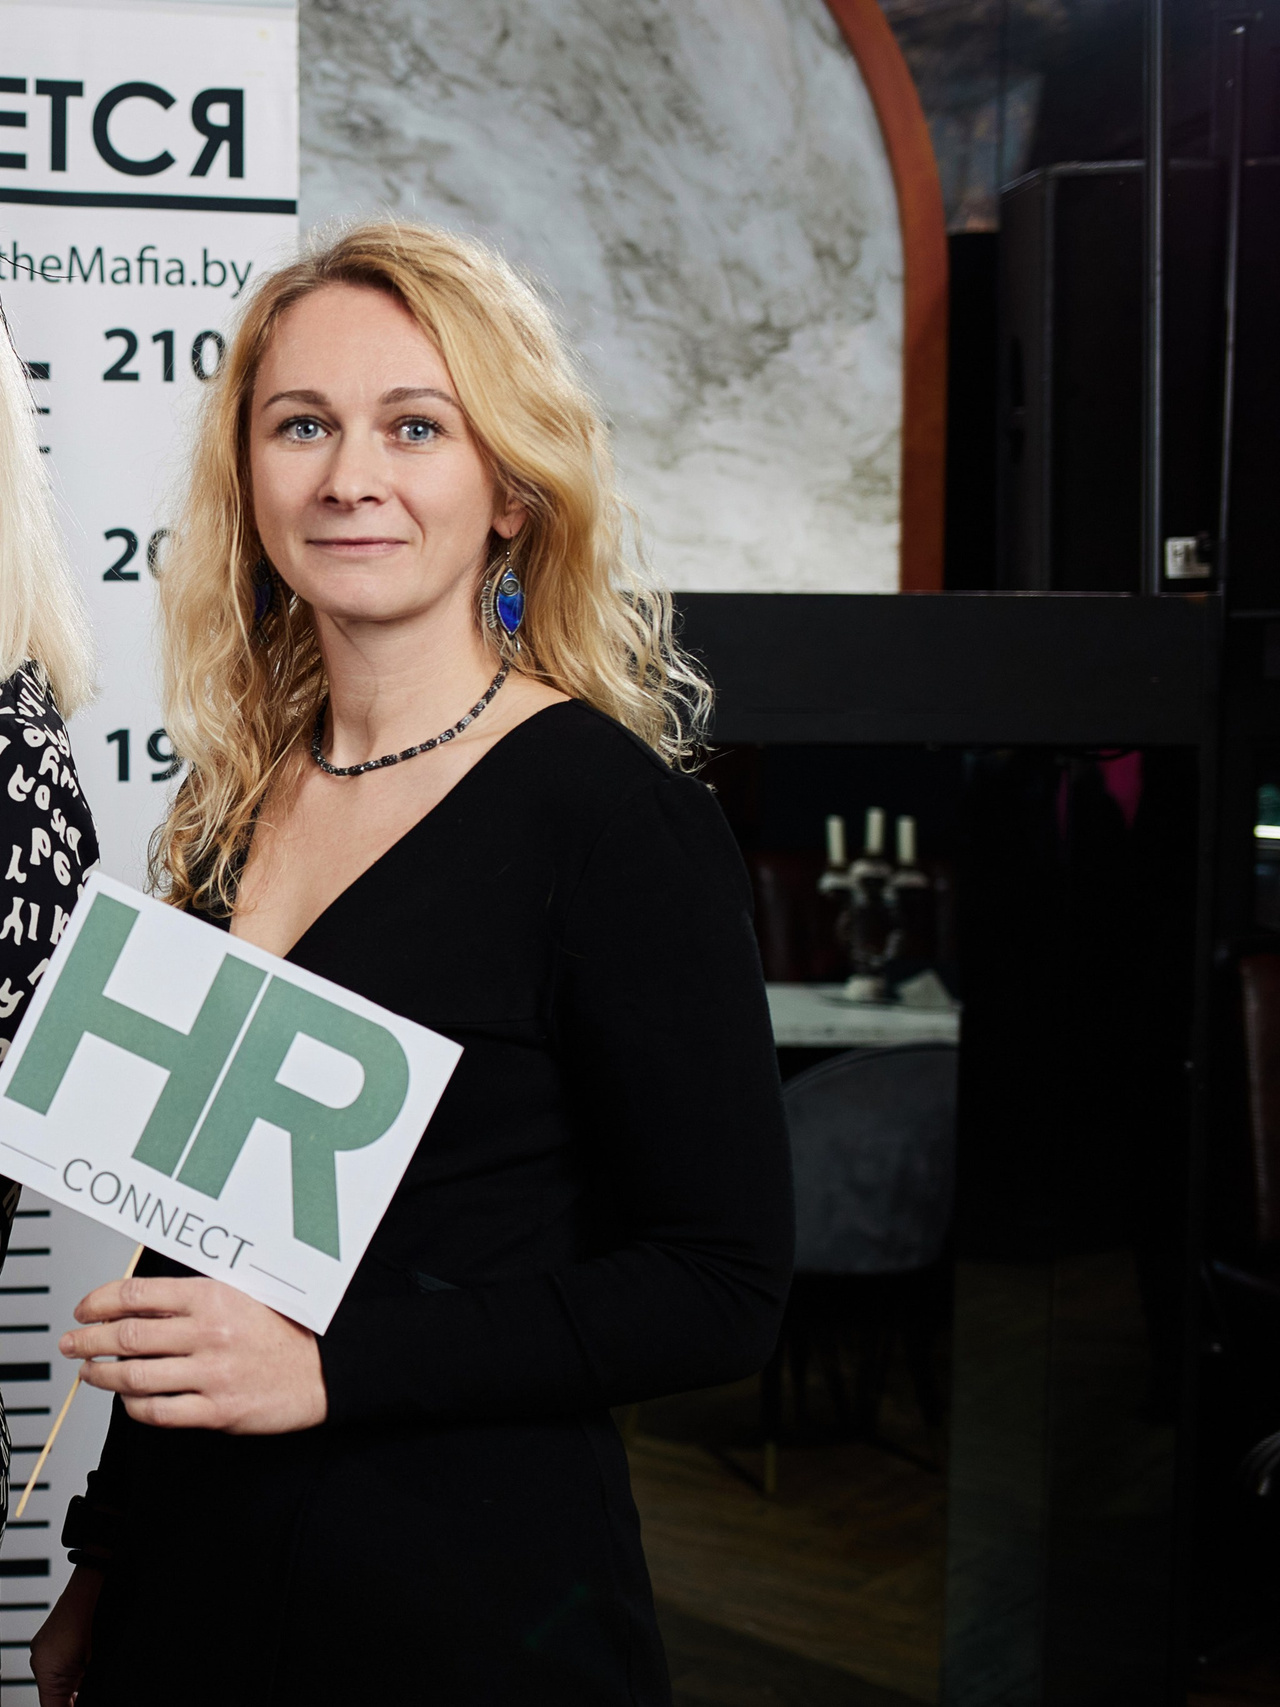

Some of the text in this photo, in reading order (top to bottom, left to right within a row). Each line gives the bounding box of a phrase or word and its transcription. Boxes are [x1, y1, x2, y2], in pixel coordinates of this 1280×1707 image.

[103, 328, 226, 383] 210
[106, 728, 183, 782] 19
[3, 891, 410, 1262] HR
[62, 1157, 254, 1270] CONNECT
